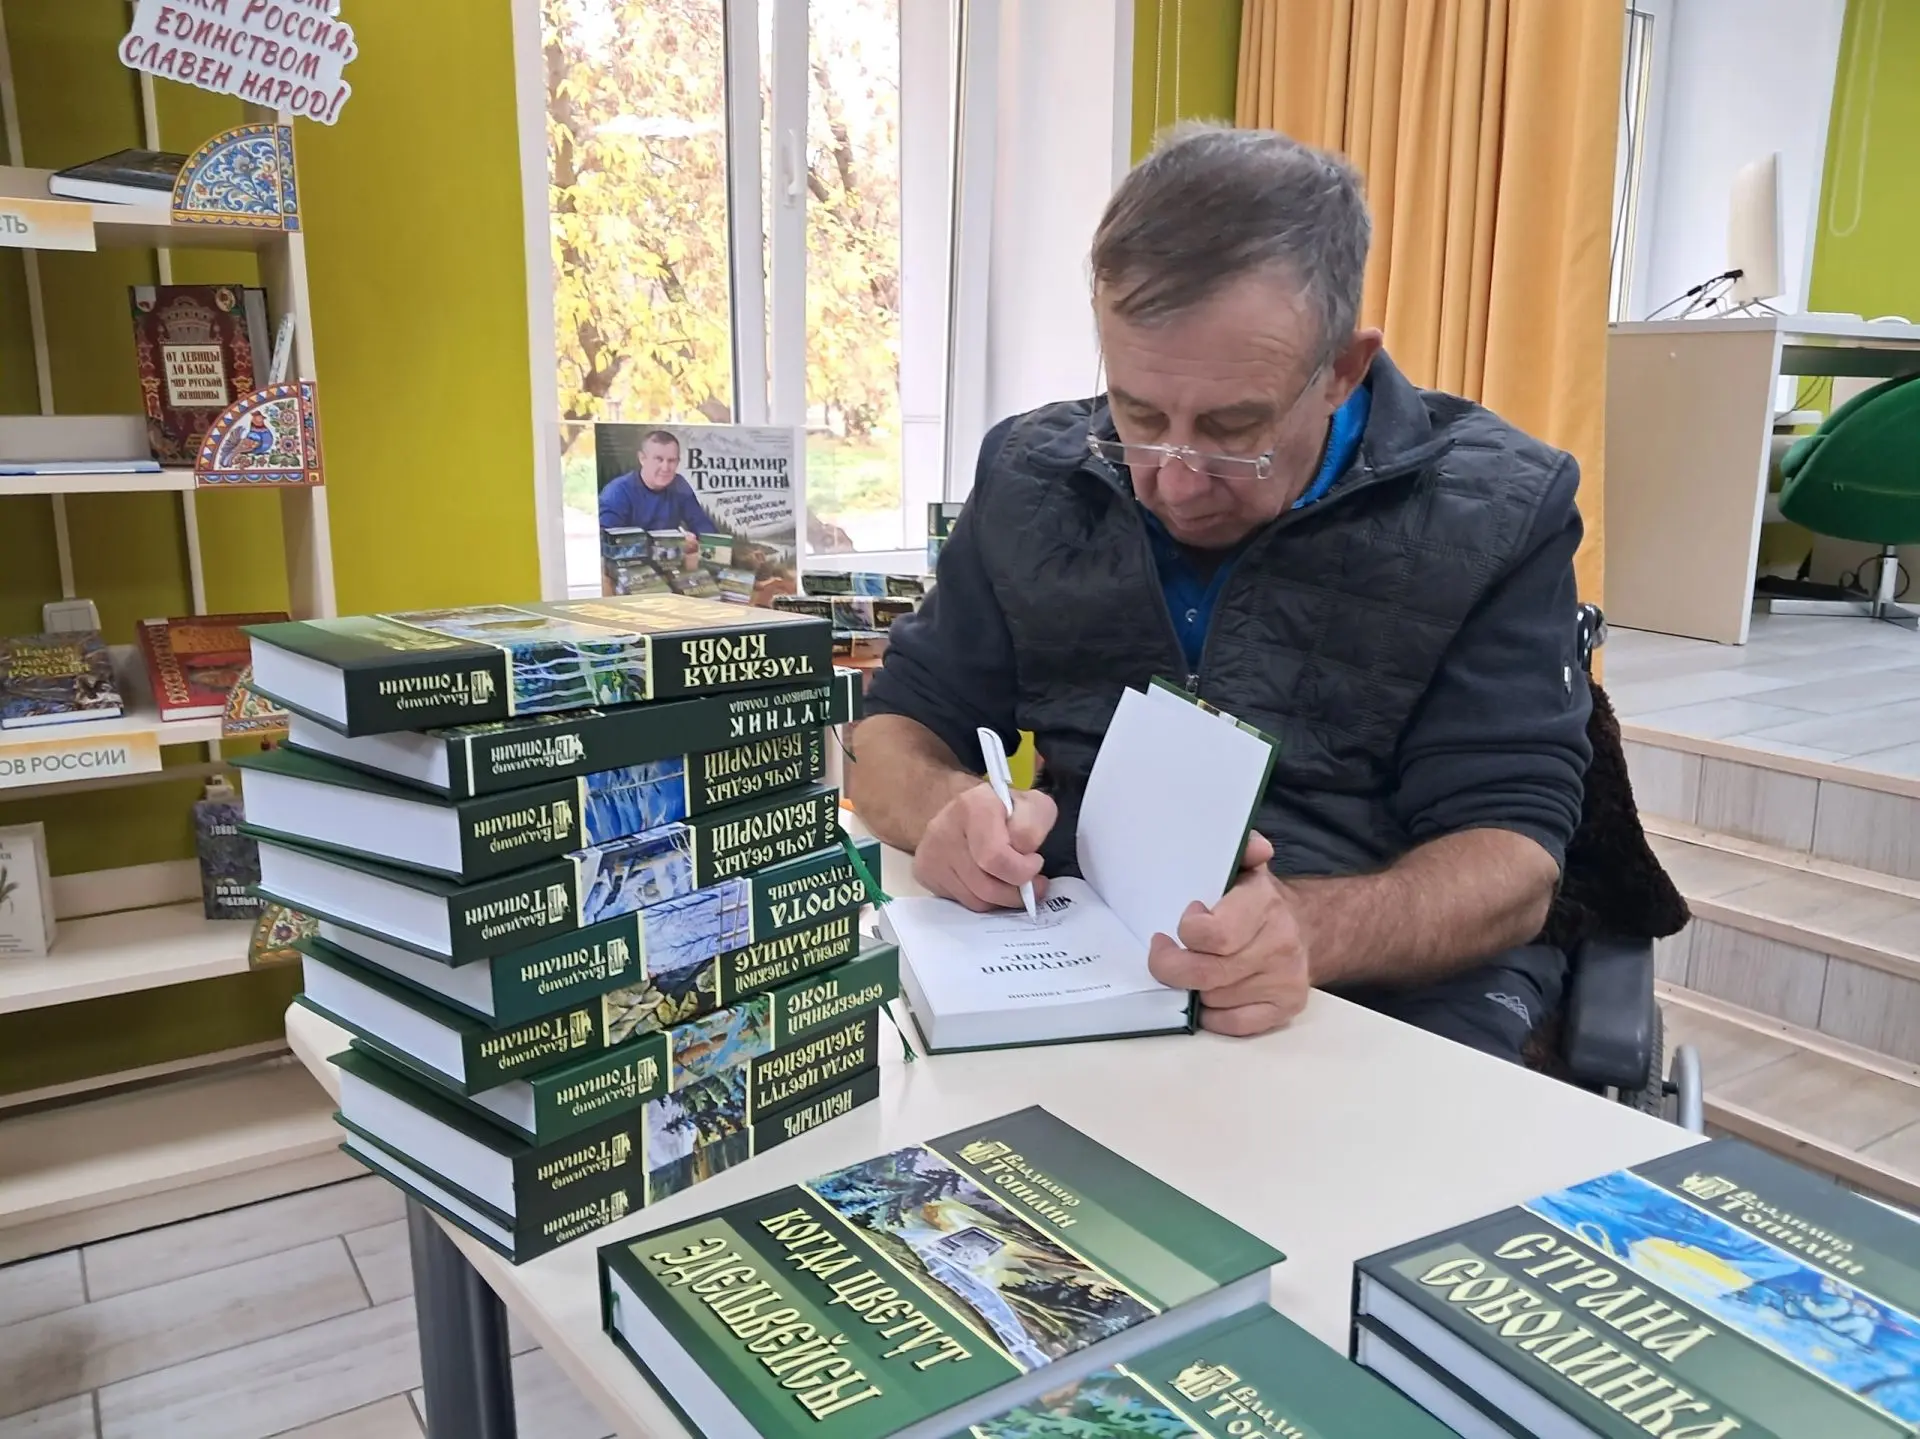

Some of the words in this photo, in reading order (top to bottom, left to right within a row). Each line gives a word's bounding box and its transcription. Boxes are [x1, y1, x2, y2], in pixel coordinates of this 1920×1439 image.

[156, 6, 321, 81] ЕДИНСТВОМ
[125, 35, 234, 89] СЛАВЕН
[239, 69, 347, 122] НАРОД!
[0, 214, 28, 234] ТЬ
[686, 447, 787, 474] Владимир
[691, 470, 786, 491] Топилин
[680, 633, 767, 666] КРОВЬ
[684, 654, 815, 688] ТАЕЖНАЯ
[396, 692, 469, 710] Владимир
[730, 700, 831, 738] ПУТНИК
[30, 748, 126, 773] РОССИИ
[492, 755, 555, 775] Владимир
[703, 732, 803, 782] БЕЛОГОРИЙ
[765, 759, 803, 787] ДОЧЬ
[706, 773, 762, 804] СЕДЫХ
[489, 826, 552, 853] Владимир
[711, 800, 817, 857] БЕЛОГОРИЙ
[775, 827, 817, 857] ДОЧЬ
[712, 845, 774, 878] СЕДЫХ
[768, 864, 853, 901] ГЛУХОМАНЬ
[768, 879, 866, 928] ВОРОТА
[481, 911, 547, 940] Владимир
[733, 915, 851, 972] ПИРАМИДЕ
[802, 937, 850, 969] ЛЕГЕНДА
[537, 963, 607, 996] Владимир
[735, 960, 790, 994] ТАЕЖНОЙ
[791, 956, 799, 971] О
[787, 979, 839, 1015] ПОЯС
[787, 983, 883, 1035] СЕРЕБРЯНЫЙ
[498, 1035, 569, 1070] Владимир
[757, 1019, 866, 1084] ЭДЕЛЬВЕЙСЫ
[822, 1047, 865, 1080] КОГДА
[571, 1084, 637, 1117] Владимир
[756, 1063, 819, 1109] ЦВЕТУТ
[783, 1088, 853, 1138] НЕМТЫРЬ
[551, 1156, 612, 1190] Владимир
[1000, 1153, 1081, 1207] Владимир
[1733, 1190, 1854, 1252] Владимир
[758, 1207, 862, 1281] КОГДА
[827, 1269, 973, 1371] ЦВЕТУТ
[1493, 1233, 1716, 1364] СТРАНА
[652, 1236, 883, 1422] ЭДЕЛЬВЕЙСЫ
